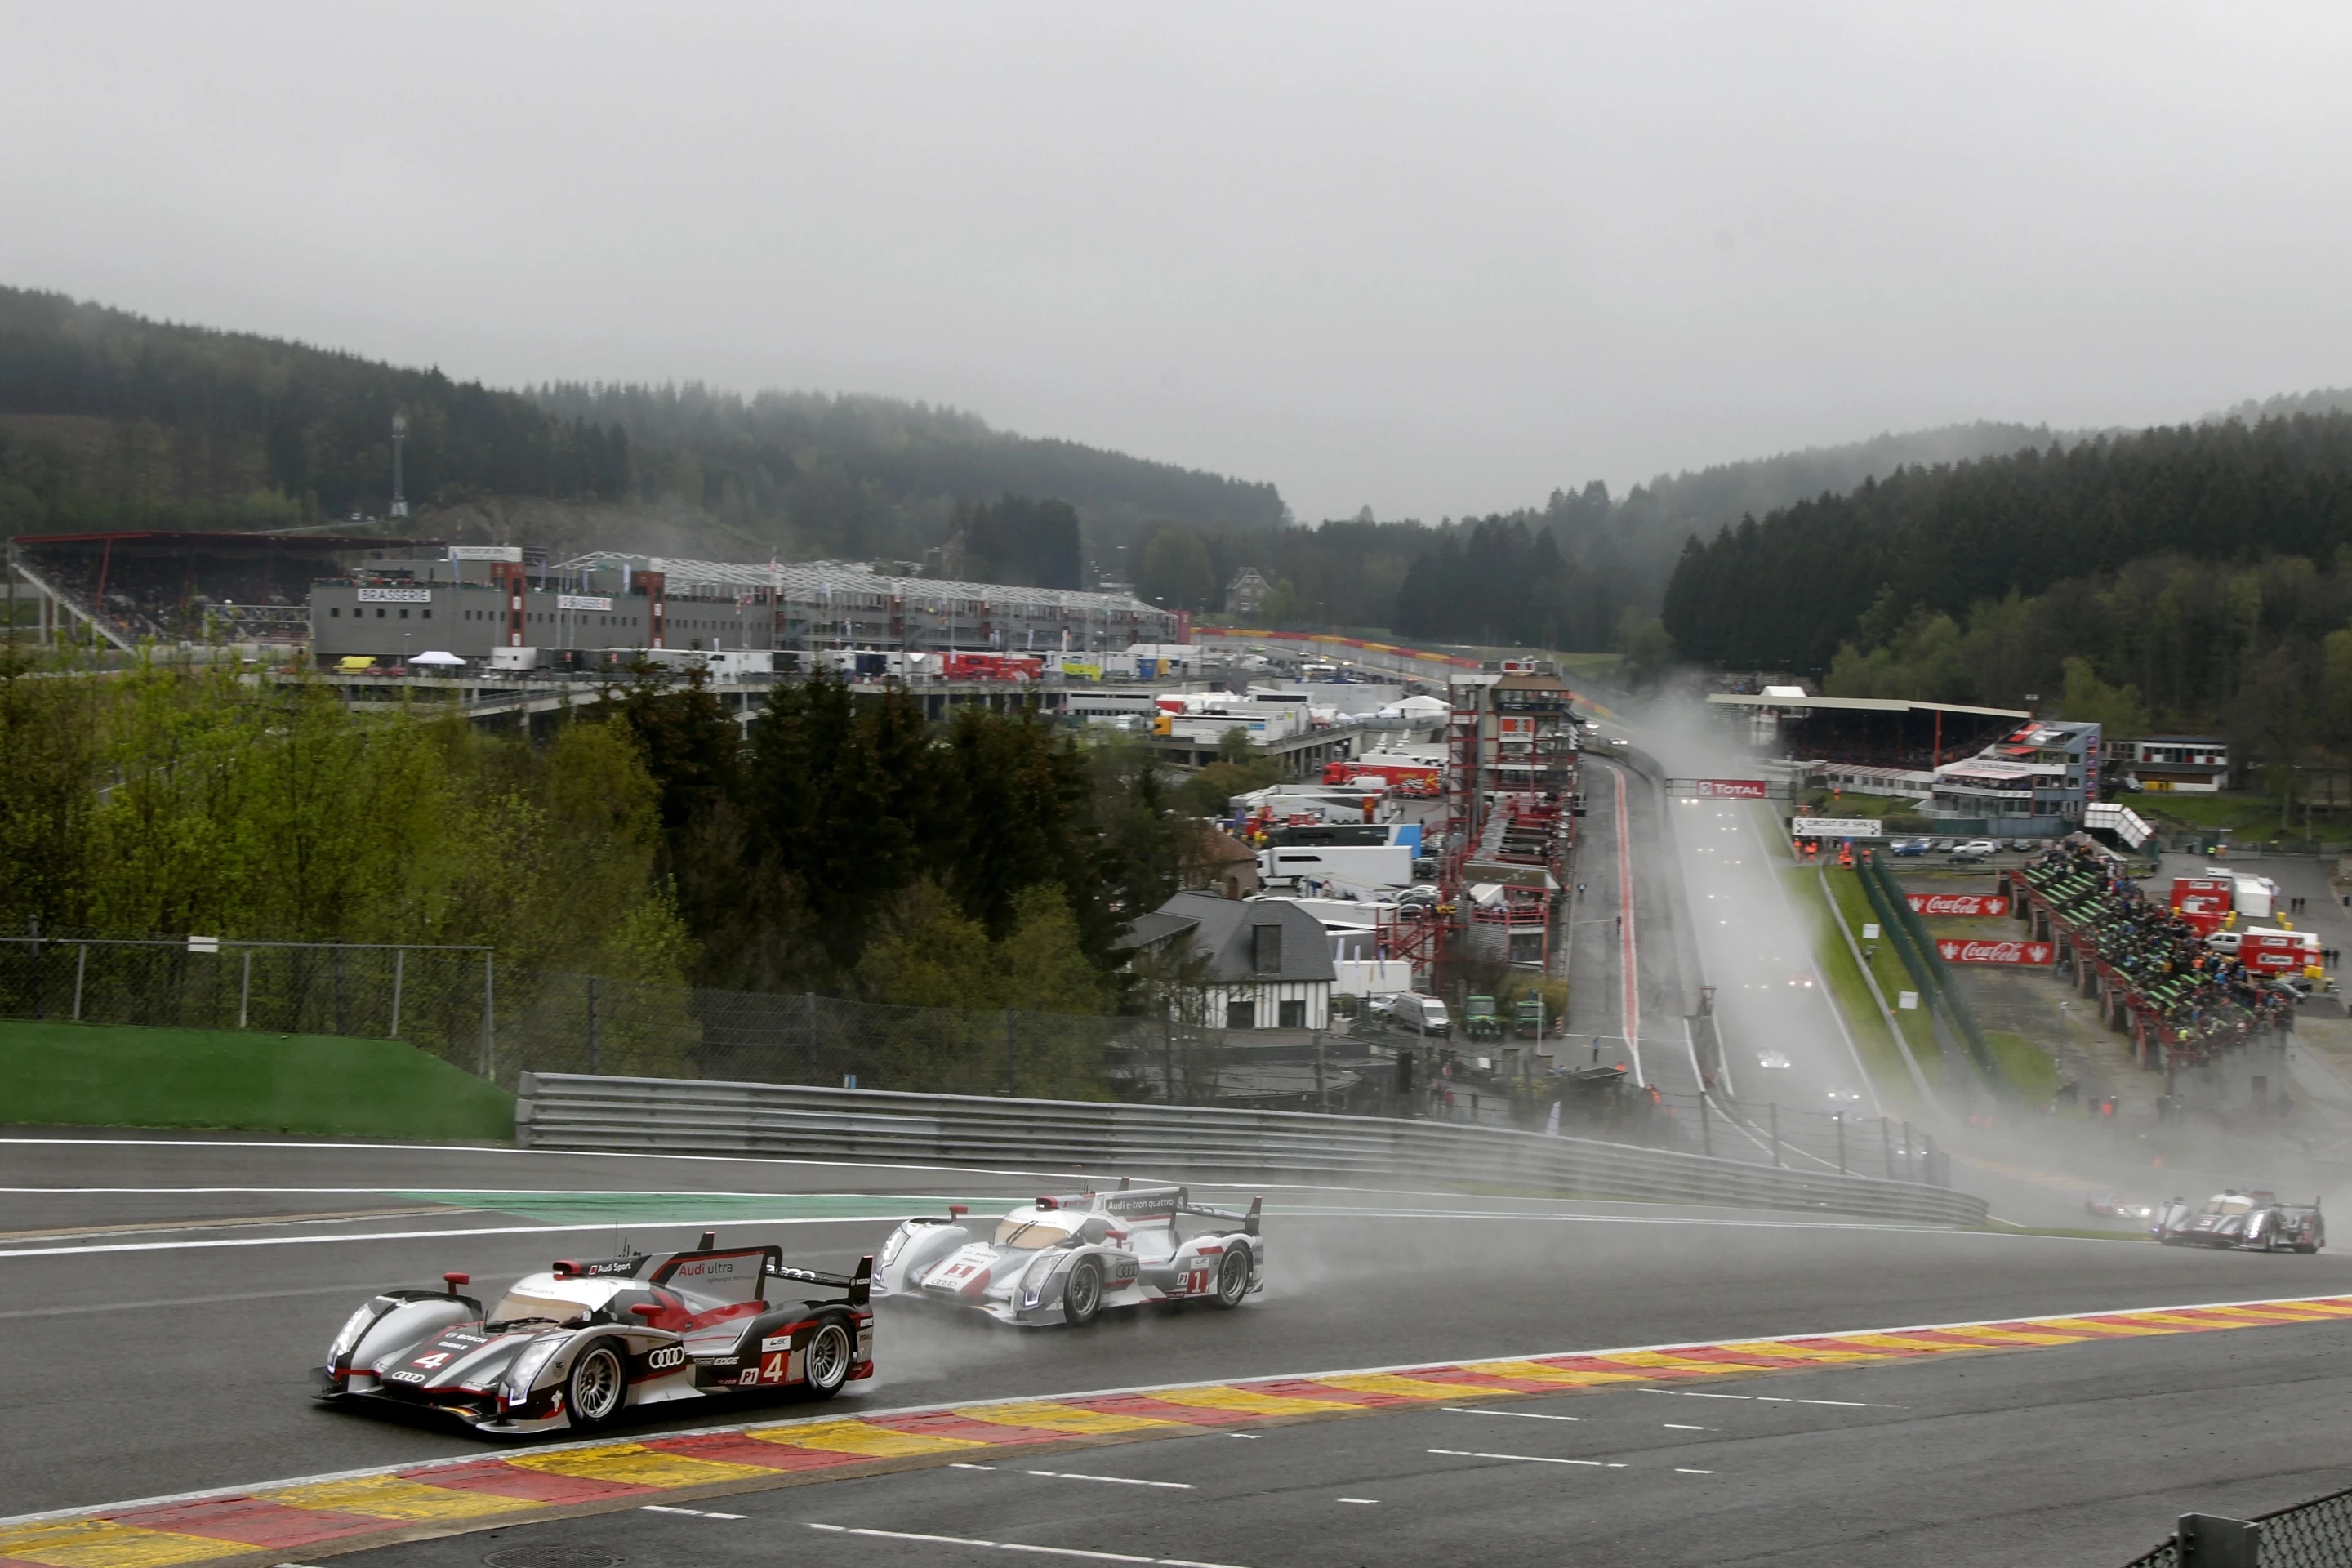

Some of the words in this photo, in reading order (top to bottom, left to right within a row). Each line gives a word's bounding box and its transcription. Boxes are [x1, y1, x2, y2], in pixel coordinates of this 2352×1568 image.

[362, 590, 427, 601] BRASSERIE
[1713, 783, 1762, 795] TOTAL
[1108, 1200, 1125, 1210] Audi
[1126, 1200, 1147, 1209] e-tron
[1148, 1199, 1174, 1208] quattro
[613, 1263, 631, 1272] Sport
[679, 1263, 705, 1276] Audi
[707, 1263, 733, 1274] ultra
[947, 1265, 969, 1277] 1
[1179, 1274, 1187, 1284] P1
[1192, 1271, 1201, 1293] 1
[457, 1334, 488, 1343] BOSCH
[770, 1338, 787, 1346] WEC
[438, 1341, 468, 1350] MAHLE
[414, 1352, 450, 1369] 4
[713, 1356, 740, 1365] EDGE
[763, 1353, 783, 1382] 4
[742, 1370, 755, 1383] P1
